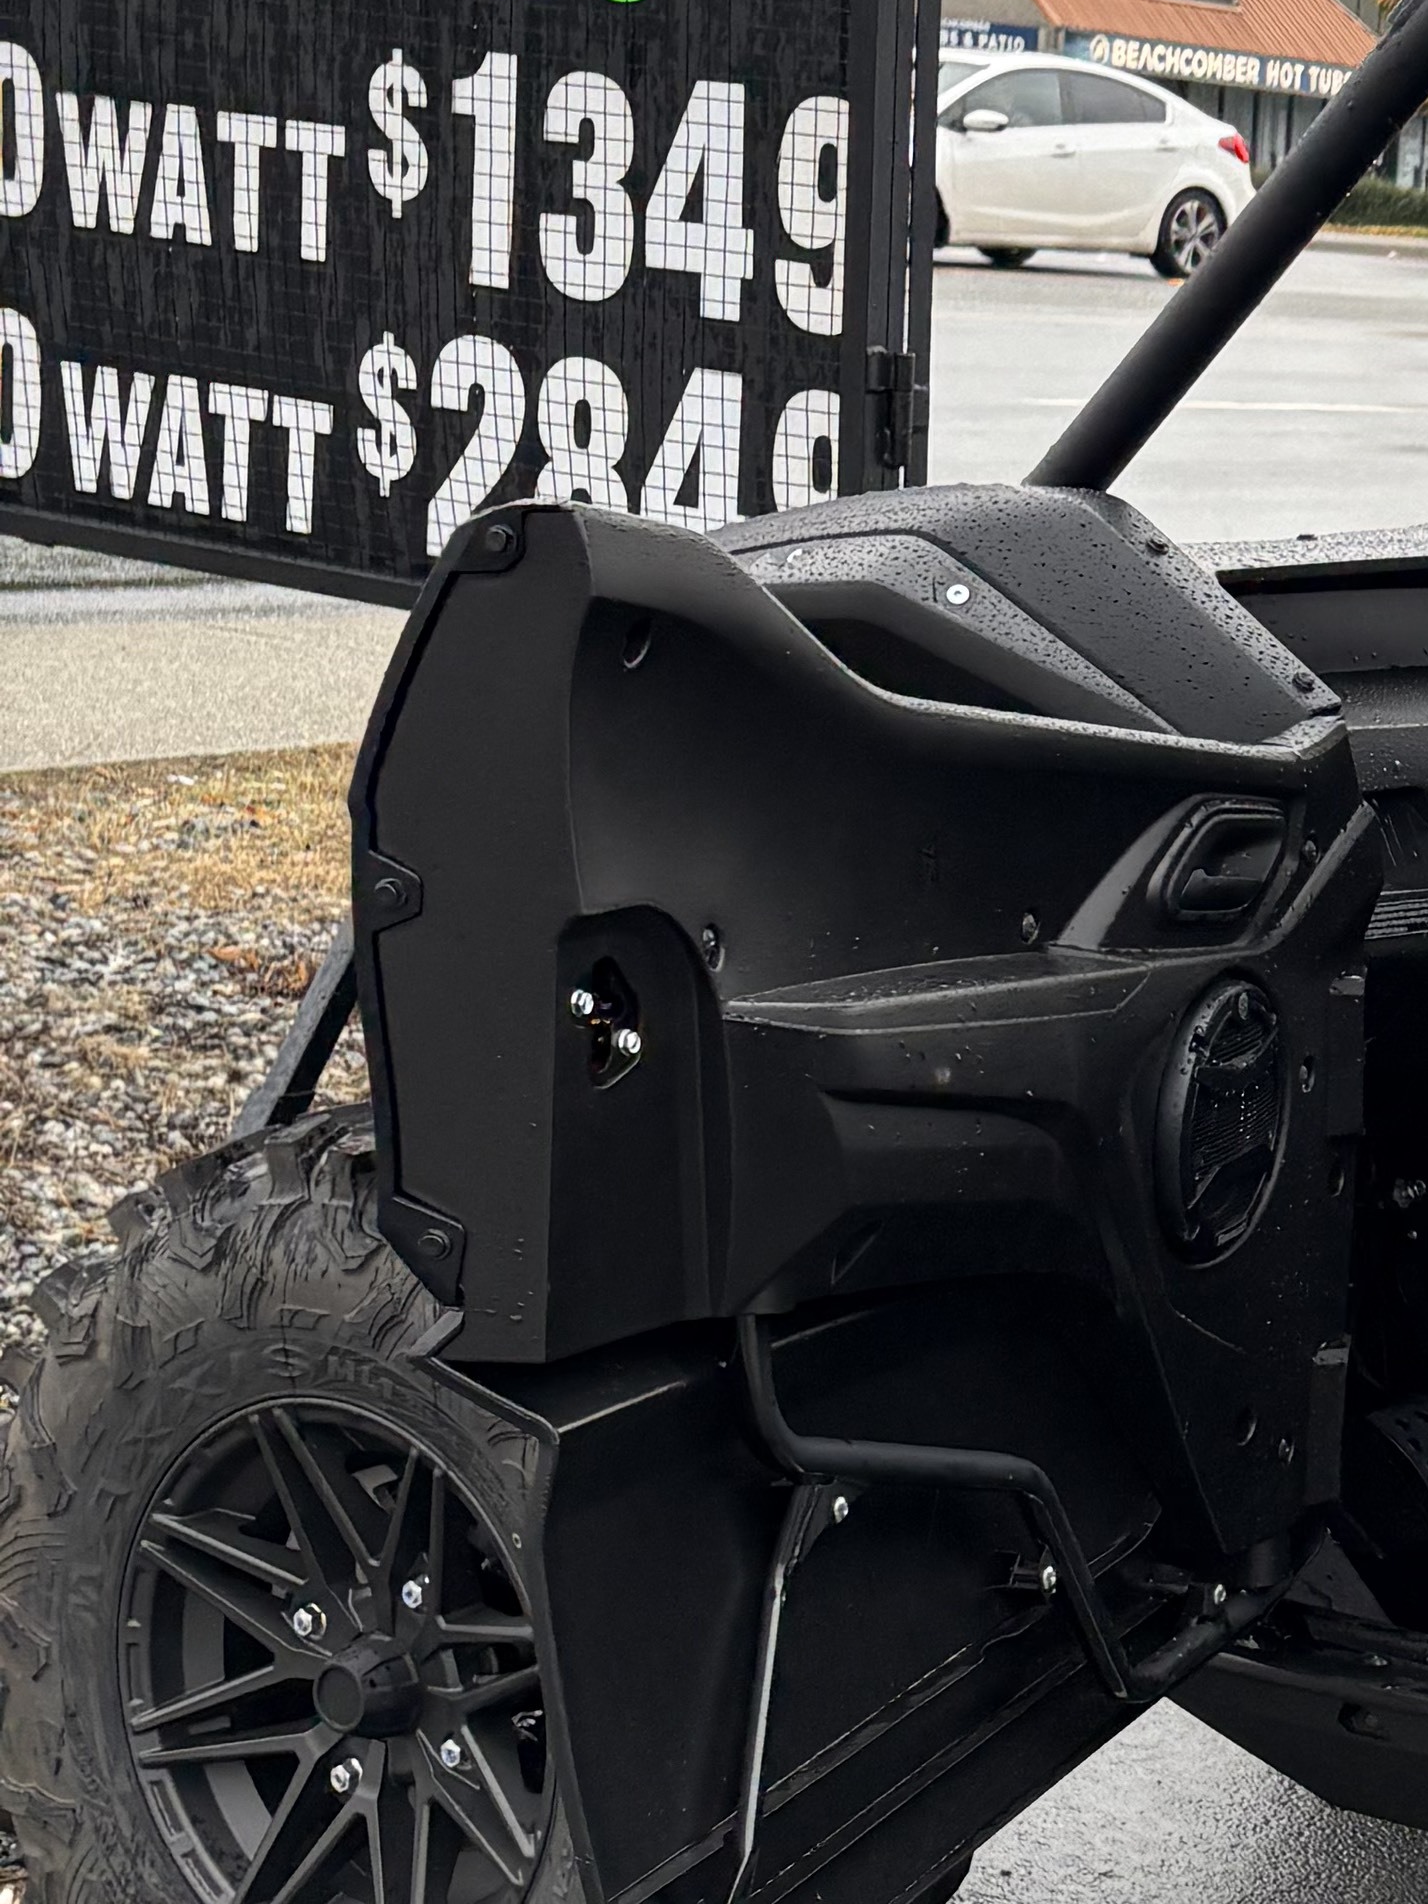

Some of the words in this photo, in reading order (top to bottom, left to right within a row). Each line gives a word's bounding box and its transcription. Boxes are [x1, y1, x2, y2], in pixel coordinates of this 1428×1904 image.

[1111, 38, 1260, 86] BEACHCOMBER
[1267, 59, 1305, 91] HOT
[55, 91, 346, 262] WATT
[366, 48, 852, 336] $1349
[60, 360, 335, 535] WATT
